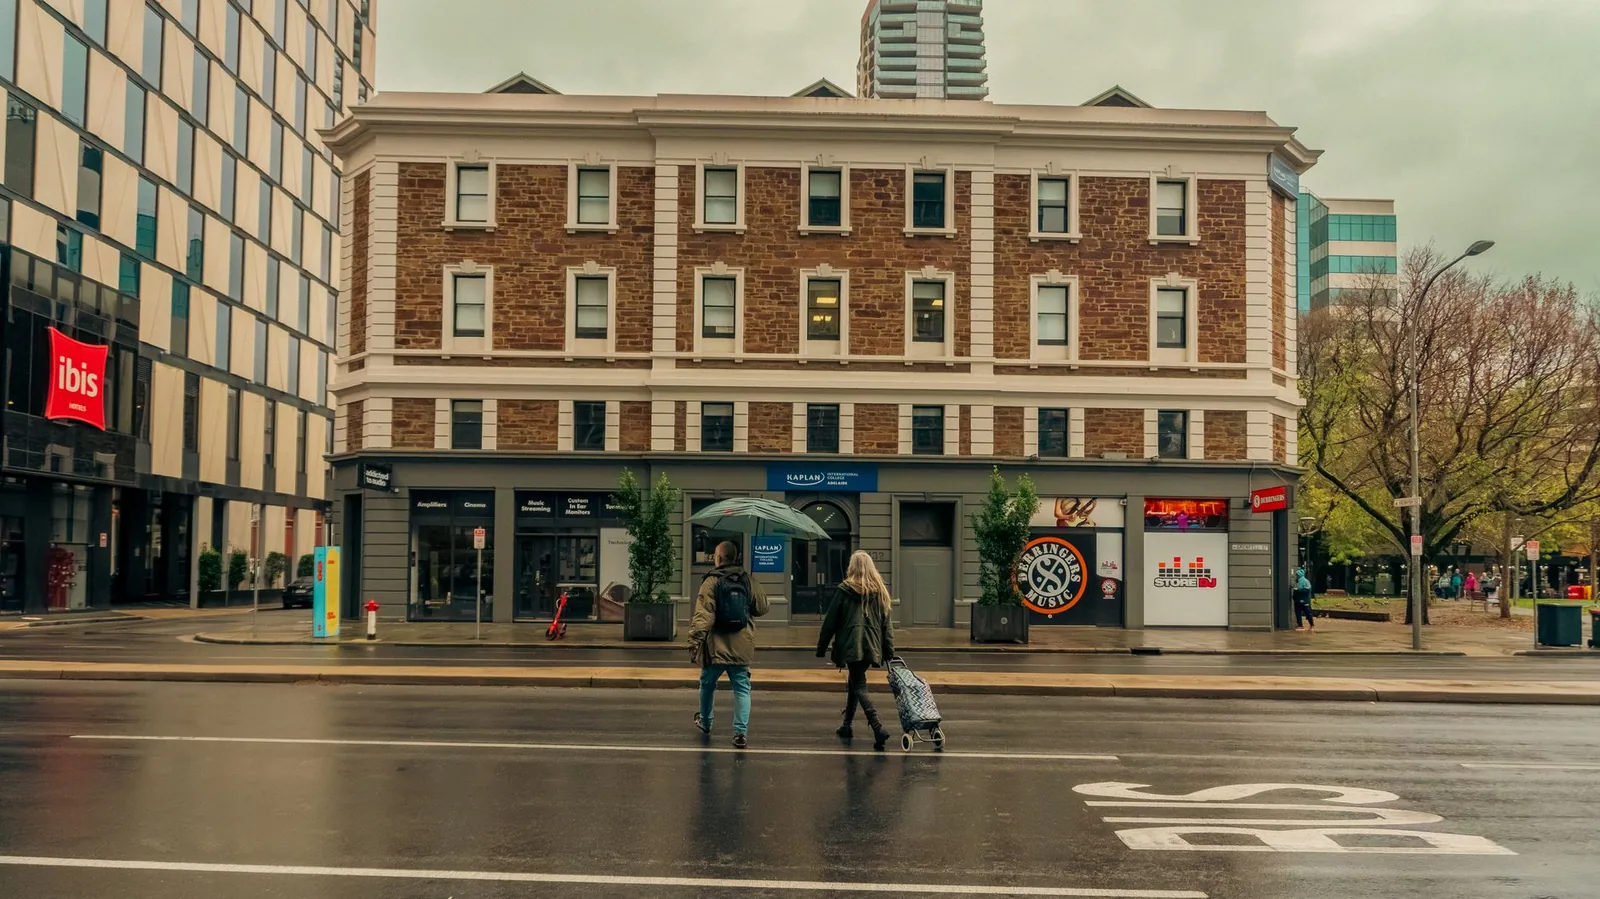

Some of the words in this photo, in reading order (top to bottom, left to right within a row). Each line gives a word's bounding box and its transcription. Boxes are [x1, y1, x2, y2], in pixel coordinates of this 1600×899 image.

[59, 355, 98, 397] ibis
[365, 470, 389, 480] addicted
[372, 478, 387, 487] audio
[1260, 494, 1285, 504] DERRINGERS
[417, 501, 447, 509] Amplifiers
[1018, 543, 1081, 583] DERRINGERS
[1154, 577, 1198, 588] STORE
[1198, 577, 1217, 589] DJ
[1025, 588, 1073, 608] MUSIC
